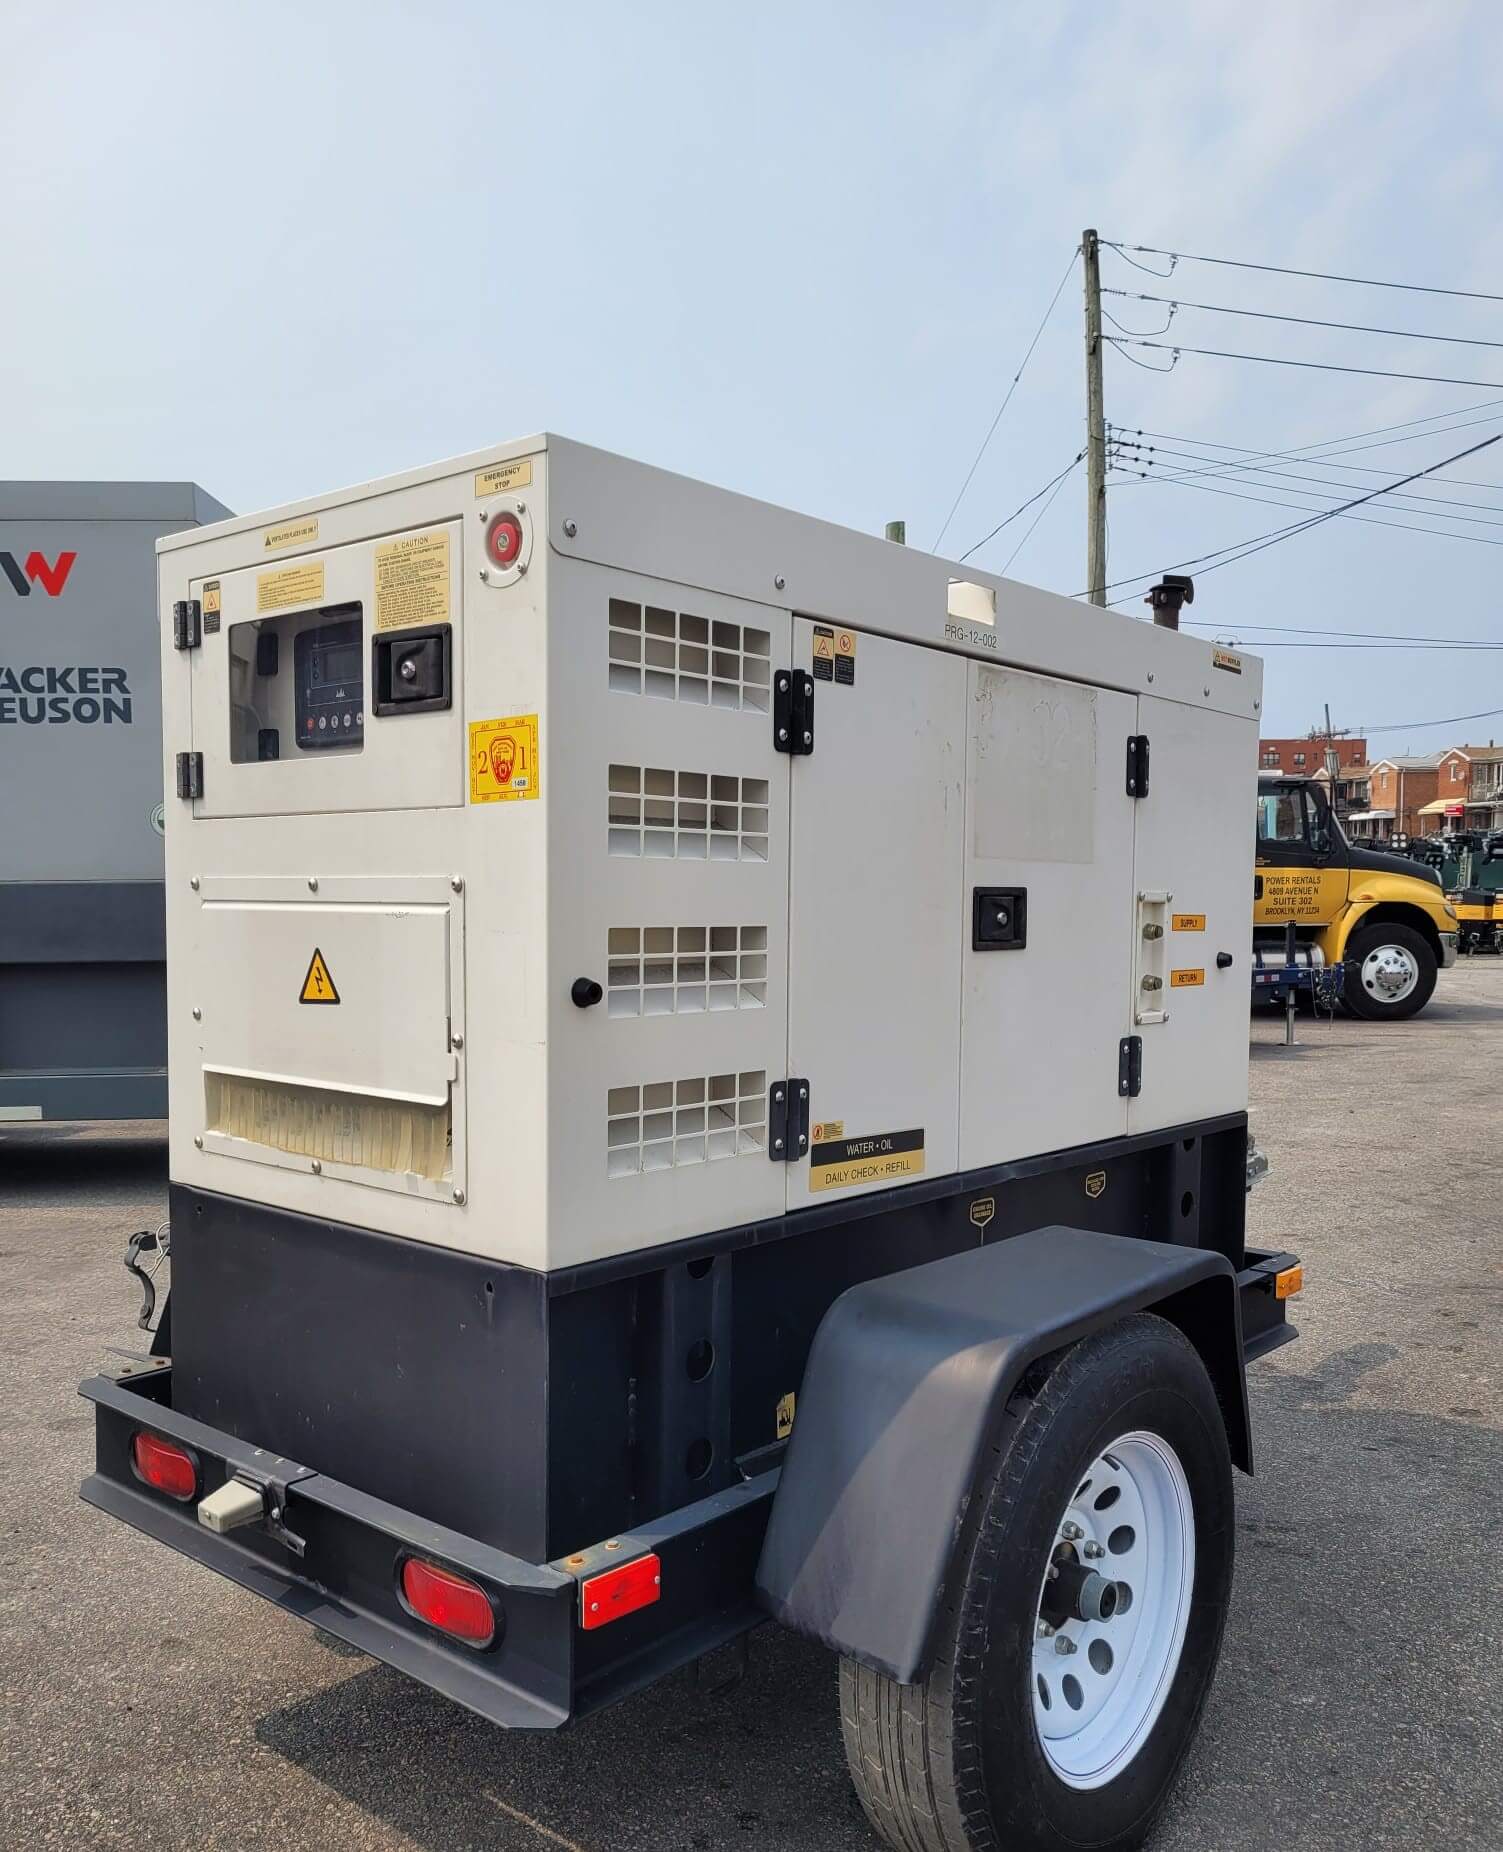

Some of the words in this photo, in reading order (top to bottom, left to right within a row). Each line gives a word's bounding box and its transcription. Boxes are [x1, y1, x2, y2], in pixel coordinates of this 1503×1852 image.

[484, 466, 520, 482] EMERGENCY
[494, 480, 510, 490] STOP
[401, 537, 428, 549] CAUTION
[944, 624, 997, 648] PRG-12-002
[0, 667, 131, 694] ACKER
[478, 751, 488, 774] 2
[519, 746, 528, 770] 1
[1266, 876, 1291, 885] POWER
[1291, 876, 1321, 885] RENTALS
[1285, 886, 1312, 895] AVENUE
[1313, 886, 1319, 895] N
[1273, 897, 1297, 906] SUITE
[1298, 896, 1313, 905] 302
[1180, 919, 1198, 928] SUPPLY
[1178, 973, 1198, 983] RETURN
[846, 1141, 875, 1156] WATER
[880, 1139, 893, 1151] OIL
[825, 1170, 849, 1185] DAILY
[850, 1165, 879, 1180] CHECK
[885, 1160, 911, 1174] REFILL
